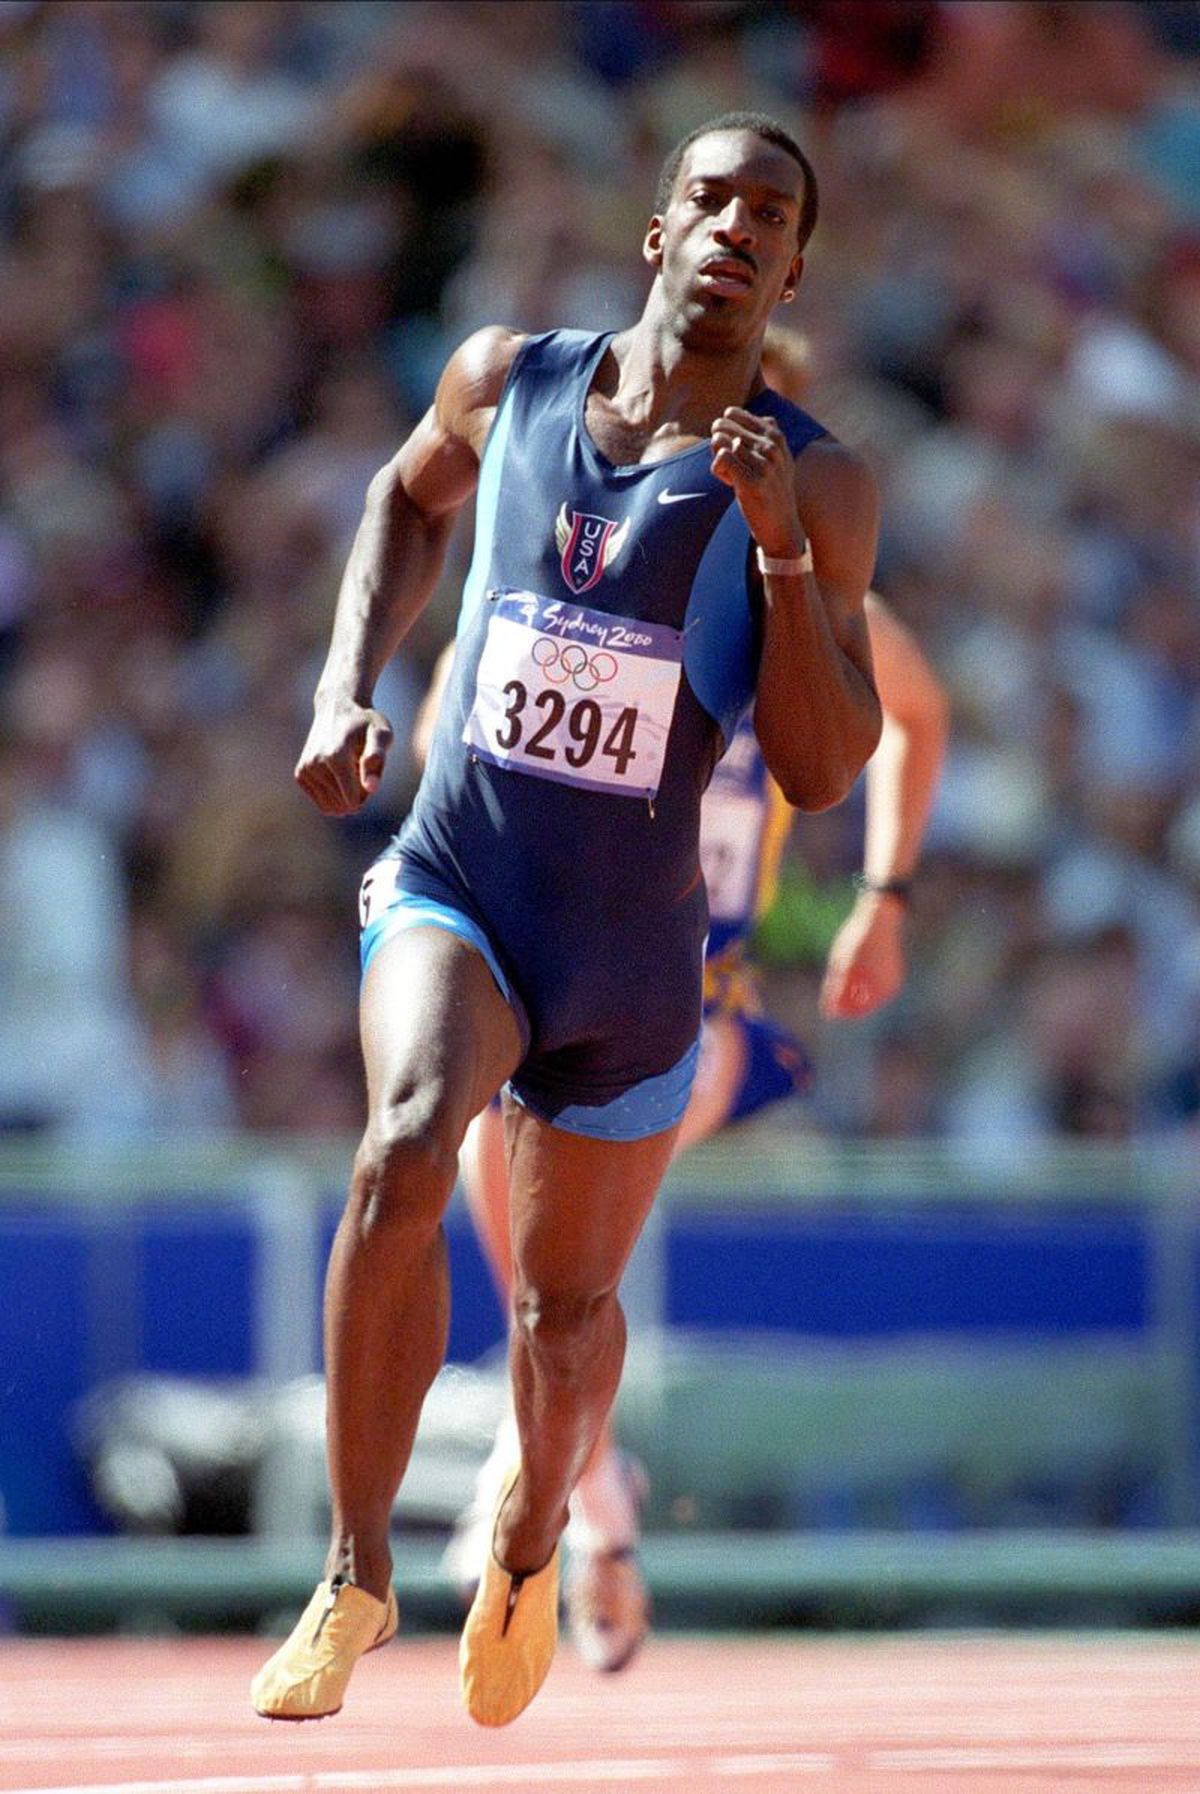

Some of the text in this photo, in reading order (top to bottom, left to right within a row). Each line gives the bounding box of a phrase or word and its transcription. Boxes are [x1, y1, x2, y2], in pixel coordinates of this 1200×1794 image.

[574, 521, 601, 575] USA
[543, 603, 653, 648] Sydney 2000
[496, 680, 639, 775] 3294
